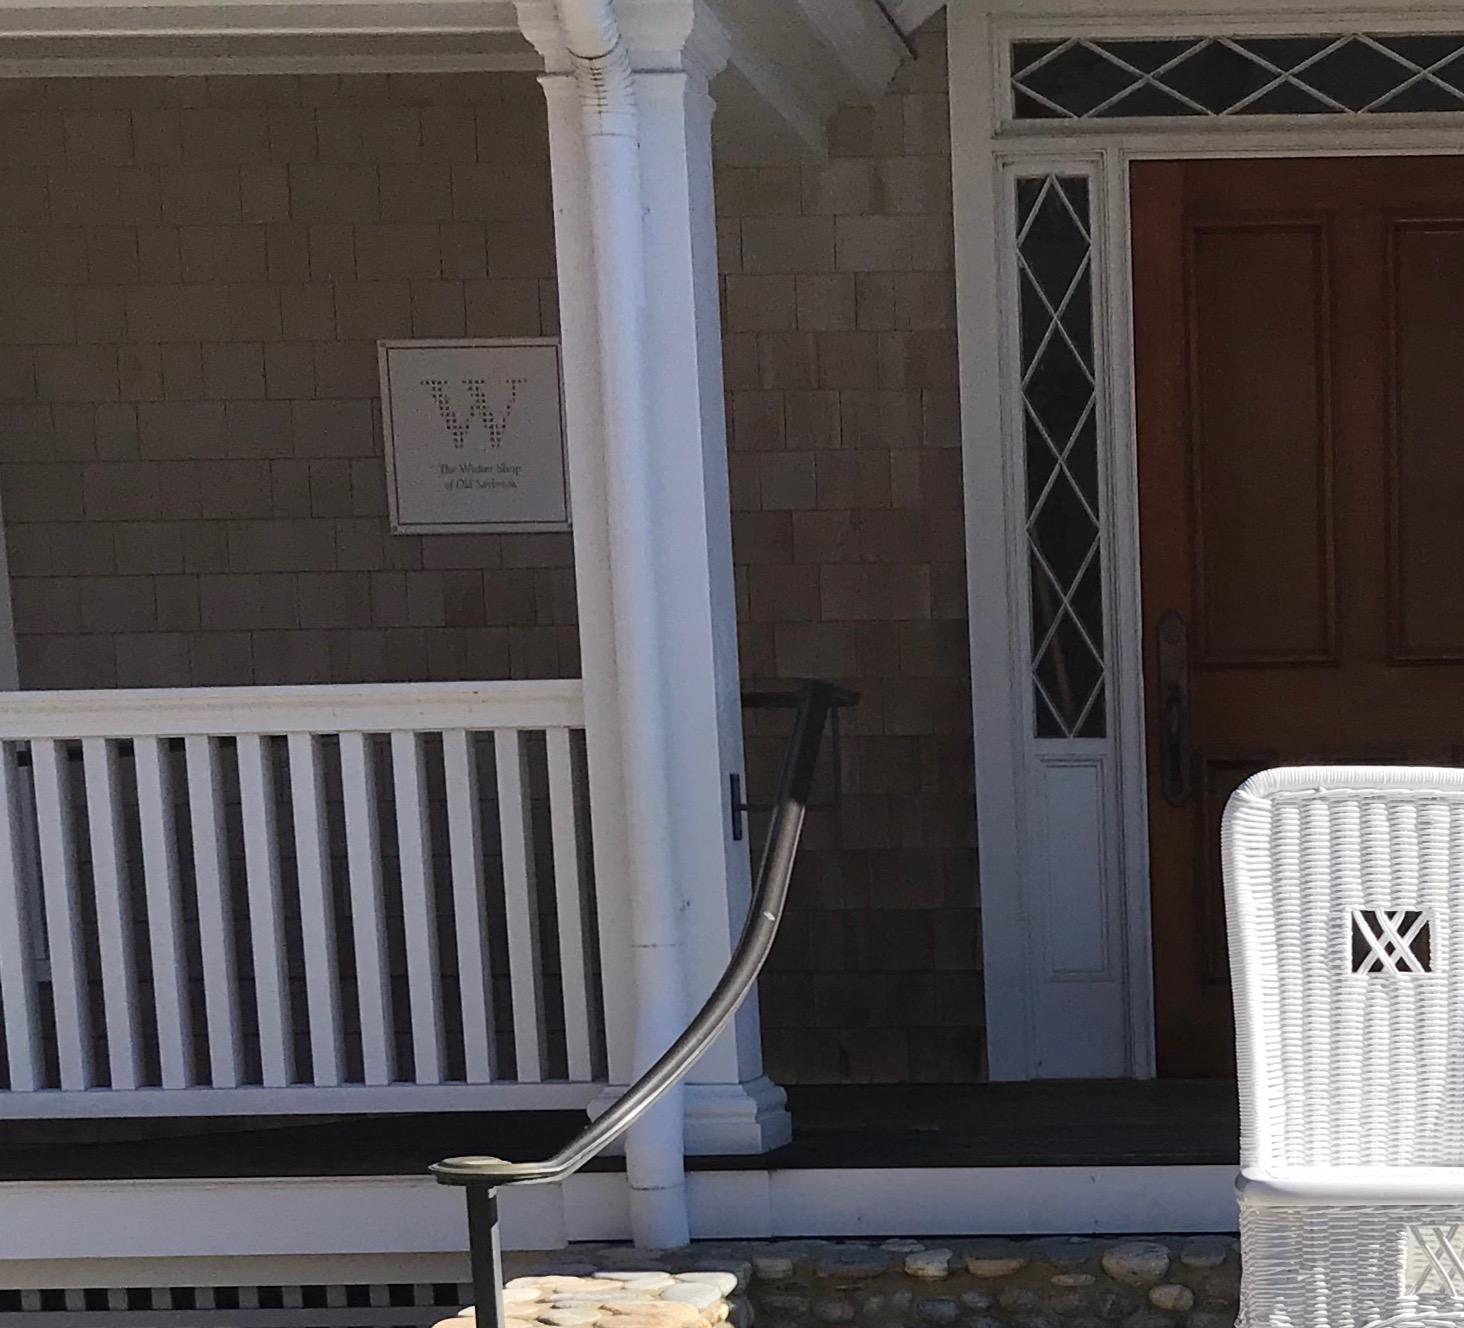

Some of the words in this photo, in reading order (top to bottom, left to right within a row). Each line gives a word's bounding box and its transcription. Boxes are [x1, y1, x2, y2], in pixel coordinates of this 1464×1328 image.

[420, 379, 527, 449] W
[439, 463, 455, 474] The
[496, 462, 521, 477] Shop
